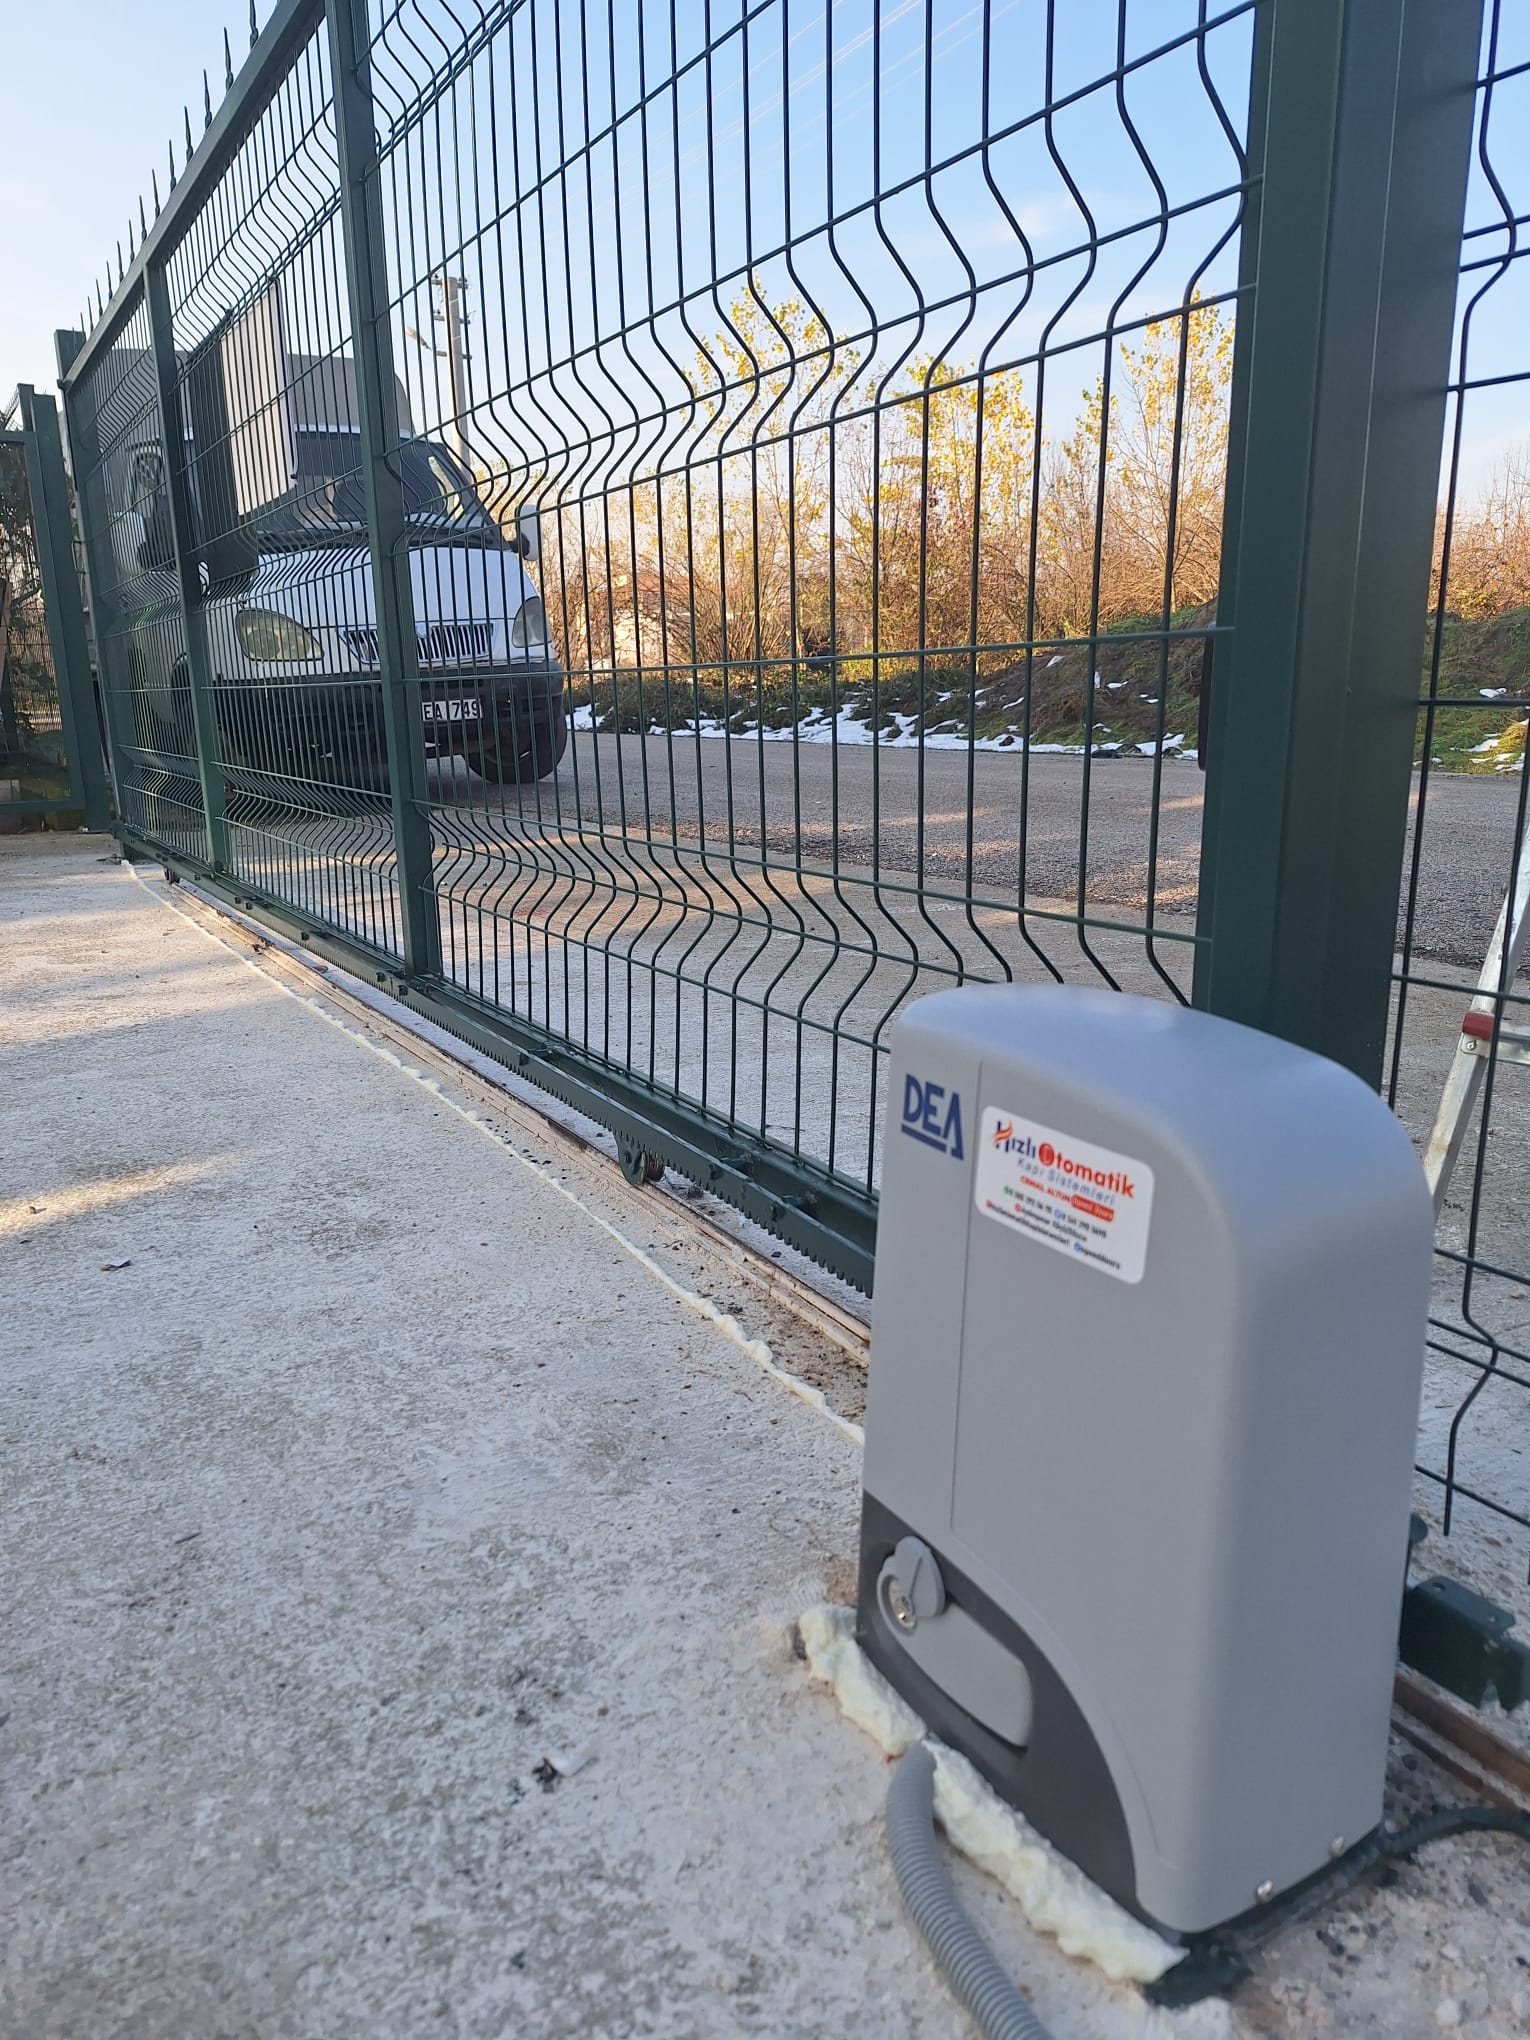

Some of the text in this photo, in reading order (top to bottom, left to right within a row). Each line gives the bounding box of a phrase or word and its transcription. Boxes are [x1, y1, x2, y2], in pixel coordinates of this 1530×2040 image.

[902, 1073, 964, 1161] DEA
[1038, 1142, 1135, 1198] Otomatik
[1047, 1167, 1115, 1205] Sistemleri
